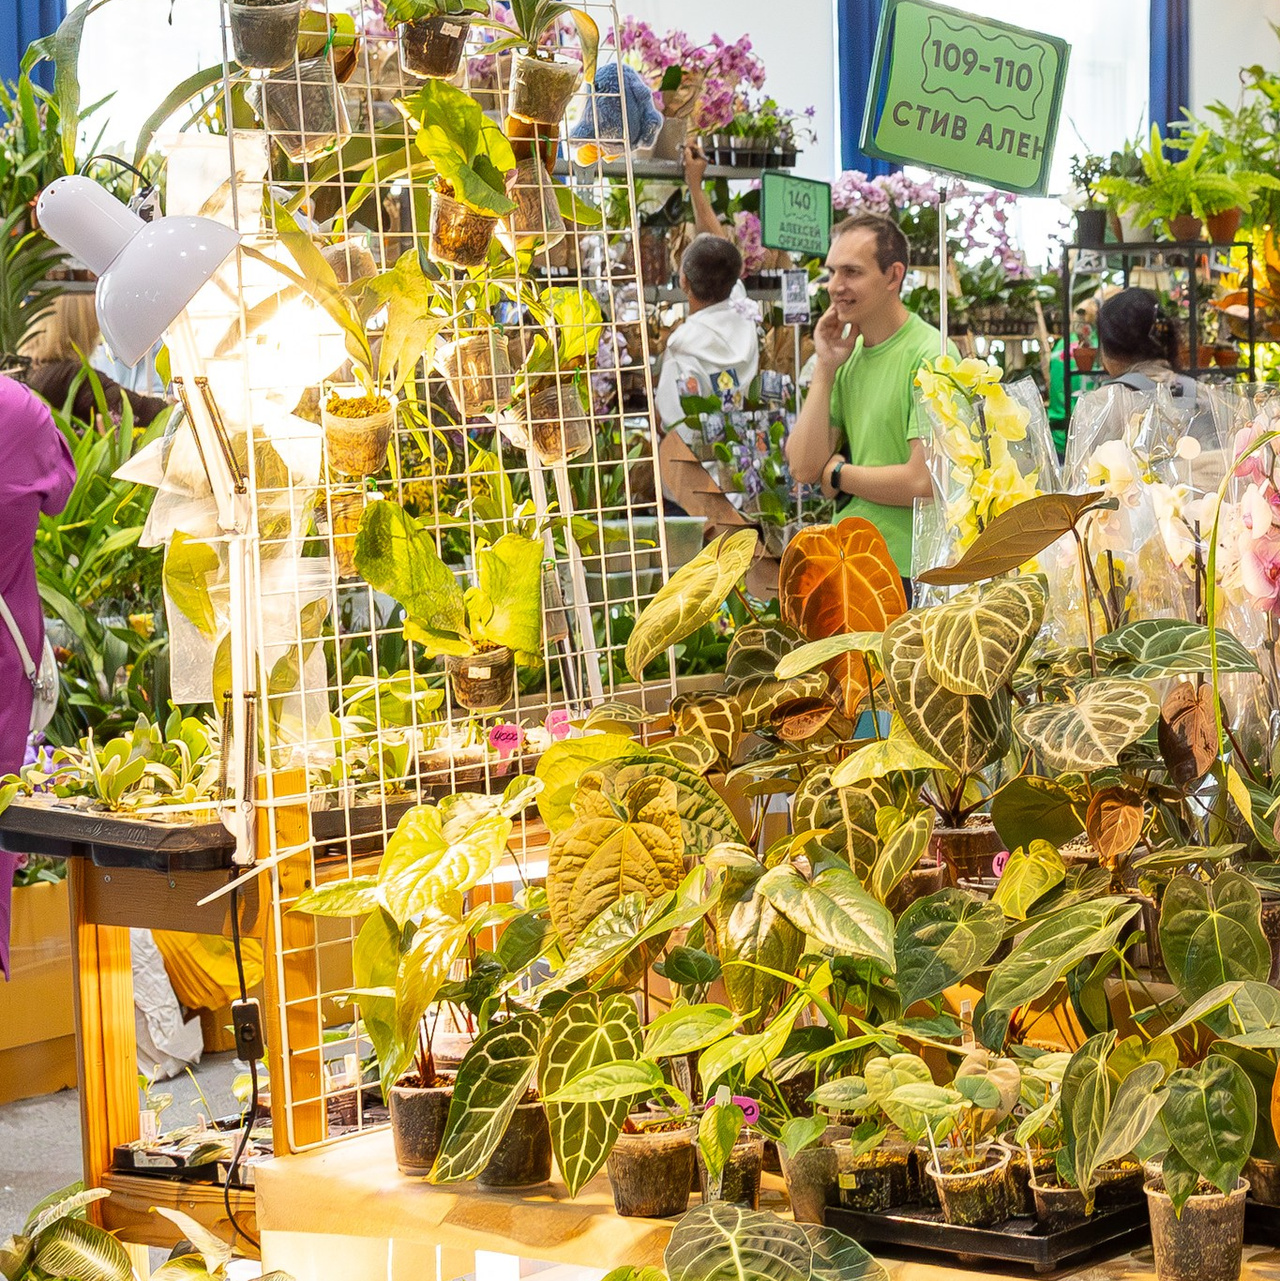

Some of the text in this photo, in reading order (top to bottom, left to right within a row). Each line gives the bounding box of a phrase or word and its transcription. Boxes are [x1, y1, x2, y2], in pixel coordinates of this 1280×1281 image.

[932, 39, 1033, 92] 109-110
[892, 100, 968, 141] СТИВ
[788, 190, 811, 211] 140
